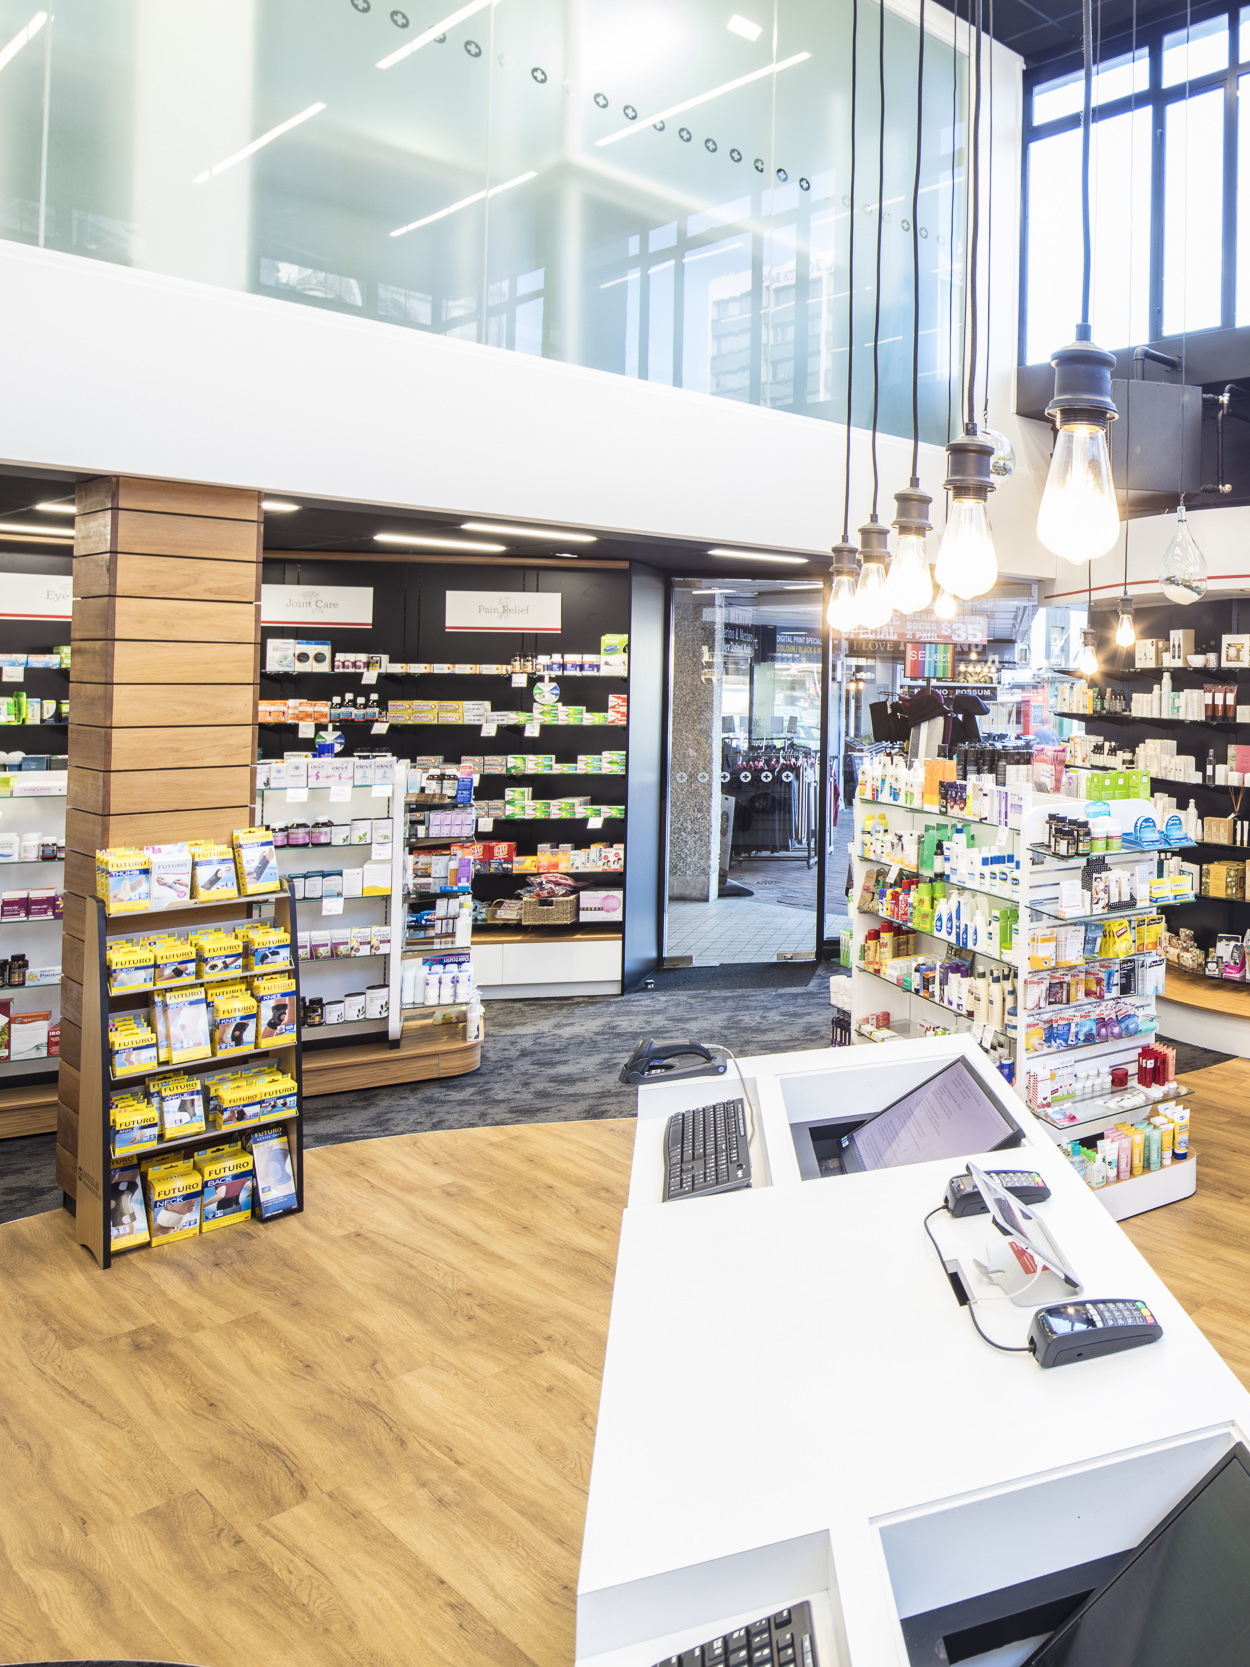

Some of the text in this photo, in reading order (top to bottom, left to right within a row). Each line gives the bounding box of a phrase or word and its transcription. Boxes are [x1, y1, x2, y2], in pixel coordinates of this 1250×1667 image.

[46, 590, 70, 602] Eye
[286, 599, 339, 608] Joint Care
[478, 605, 529, 614] Pain Relief
[906, 622, 937, 630] SOCKS
[941, 621, 983, 642] $35
[776, 635, 792, 643] DIGITAL
[793, 636, 805, 644] PRINT
[776, 645, 795, 653] COLOUR
[798, 645, 812, 653] BLACK
[862, 641, 894, 651] LOVE
[241, 833, 270, 841] FUTURO
[197, 850, 231, 859] FUTURO
[111, 860, 147, 869] FUTURO
[157, 862, 187, 870] FUTURO
[1147, 917, 1164, 926] ChapStick
[257, 937, 288, 948] FUTURO
[208, 943, 241, 954] FUTURO
[160, 950, 193, 961] FUTURO
[115, 957, 152, 967] FUTURO
[160, 961, 179, 969] ELBOW
[115, 966, 136, 974] ELBOW
[263, 981, 294, 992] FUTURO
[168, 989, 203, 1000] FUTURO
[210, 988, 243, 998] FUTURO
[263, 993, 282, 1001] KNEE
[169, 1001, 190, 1010] KNEE
[222, 1004, 255, 1015] FUTURO
[221, 1016, 241, 1025] KNEE
[118, 1036, 154, 1048] FUTURO
[118, 1047, 134, 1055] KNEE
[163, 1081, 198, 1093] FUTURO
[263, 1085, 296, 1098] FUTURO
[164, 1092, 189, 1102] ANKLE
[228, 1093, 258, 1105] FUTURO
[119, 1116, 156, 1128] FUTURO
[254, 1126, 283, 1138] FUTURO
[111, 1156, 134, 1166] TURO
[208, 1161, 249, 1178] FUTURO
[207, 1175, 232, 1187] BACK
[157, 1183, 199, 1198] FUTURO
[156, 1195, 184, 1208] NECK
